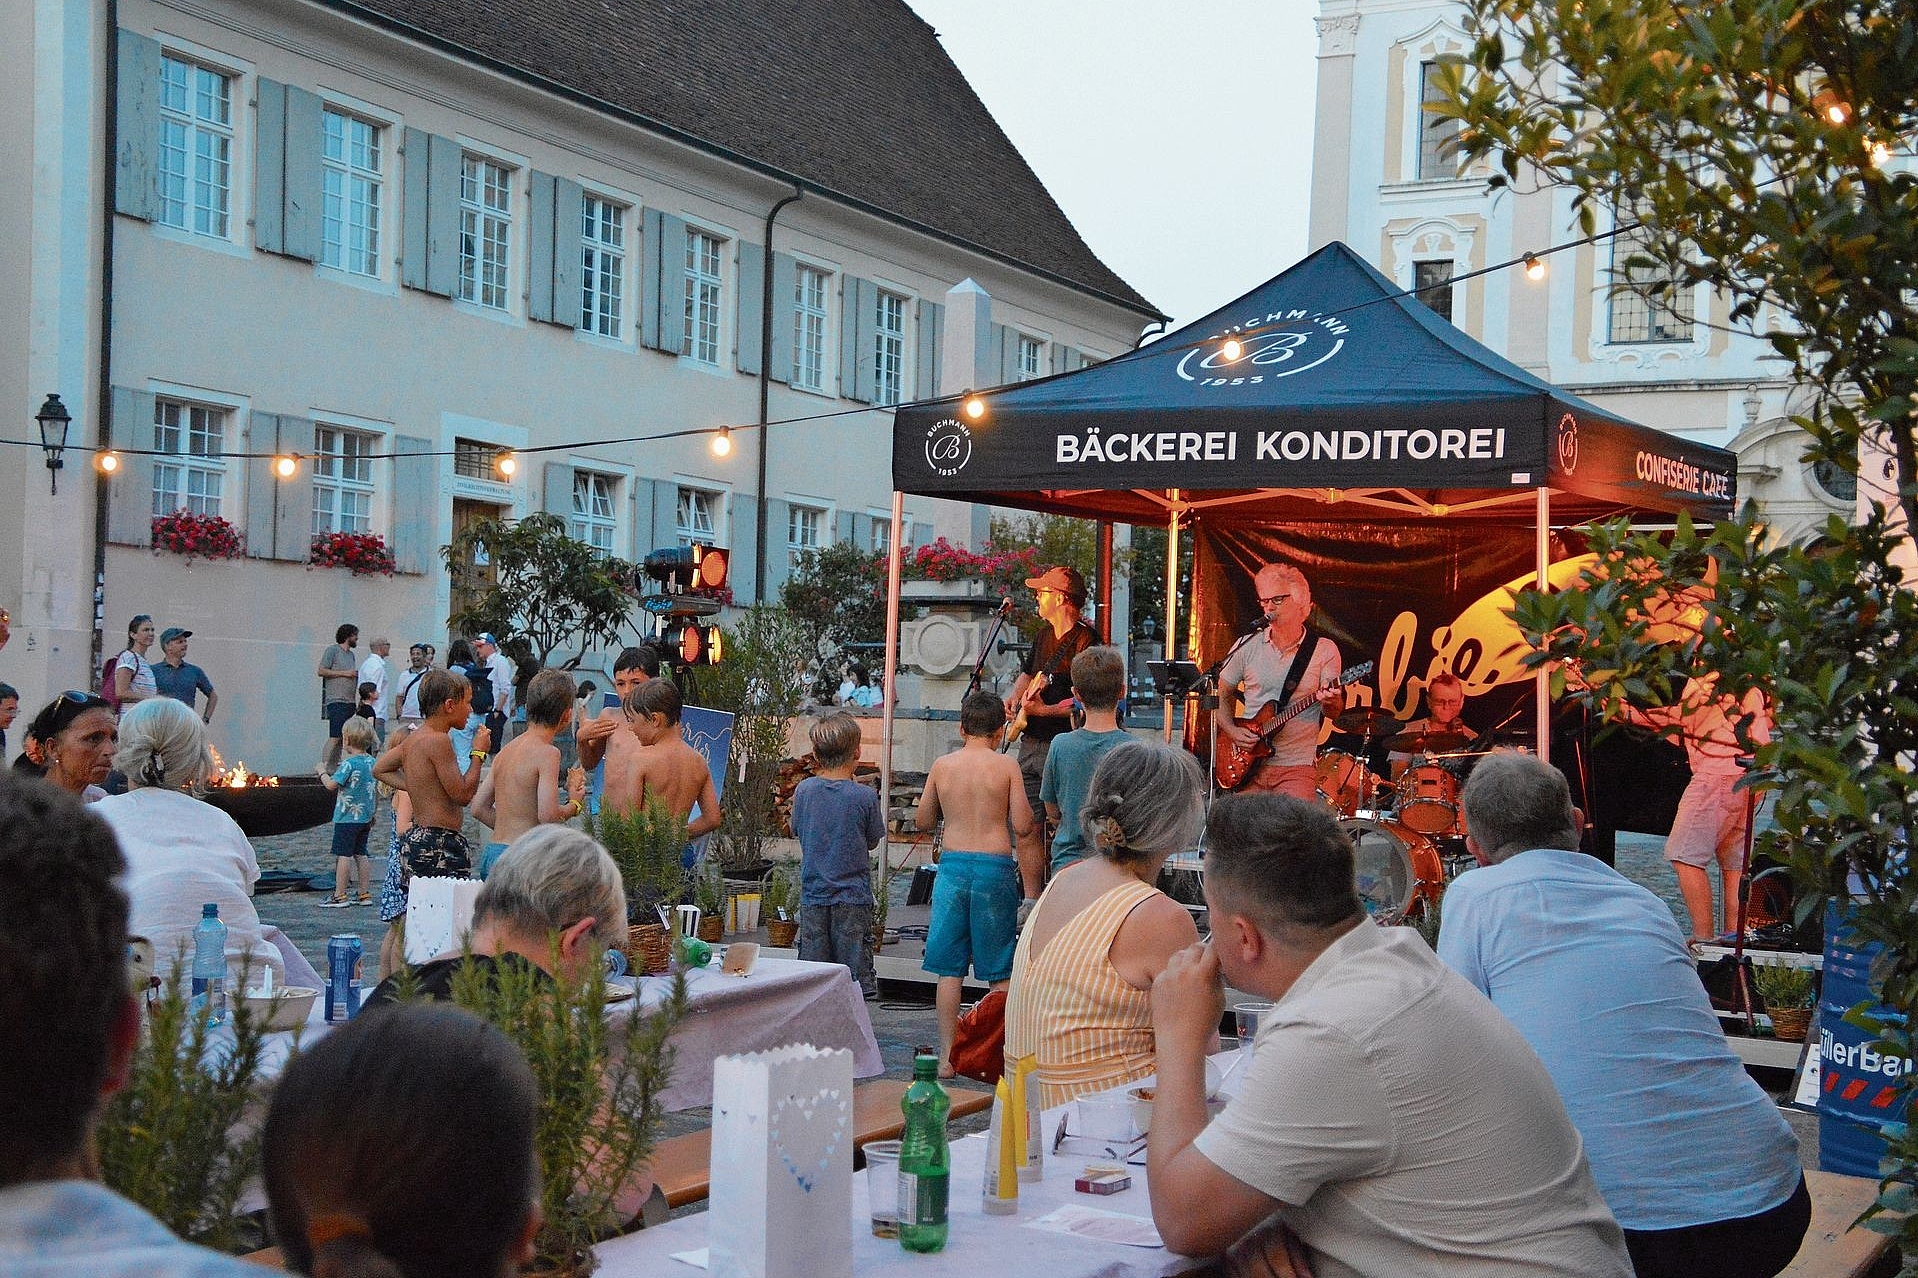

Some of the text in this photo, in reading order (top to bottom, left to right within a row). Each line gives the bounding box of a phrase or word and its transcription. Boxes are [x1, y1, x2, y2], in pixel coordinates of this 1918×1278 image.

[1208, 309, 1350, 341] CHMNN
[1200, 375, 1264, 386] 1953
[927, 419, 970, 438] BUCHMANN
[1056, 427, 1505, 463] BÄCKEREI KONDITOREI
[938, 467, 957, 476] 1953
[1636, 450, 1730, 501] CONFISÉRIE CAFÉ
